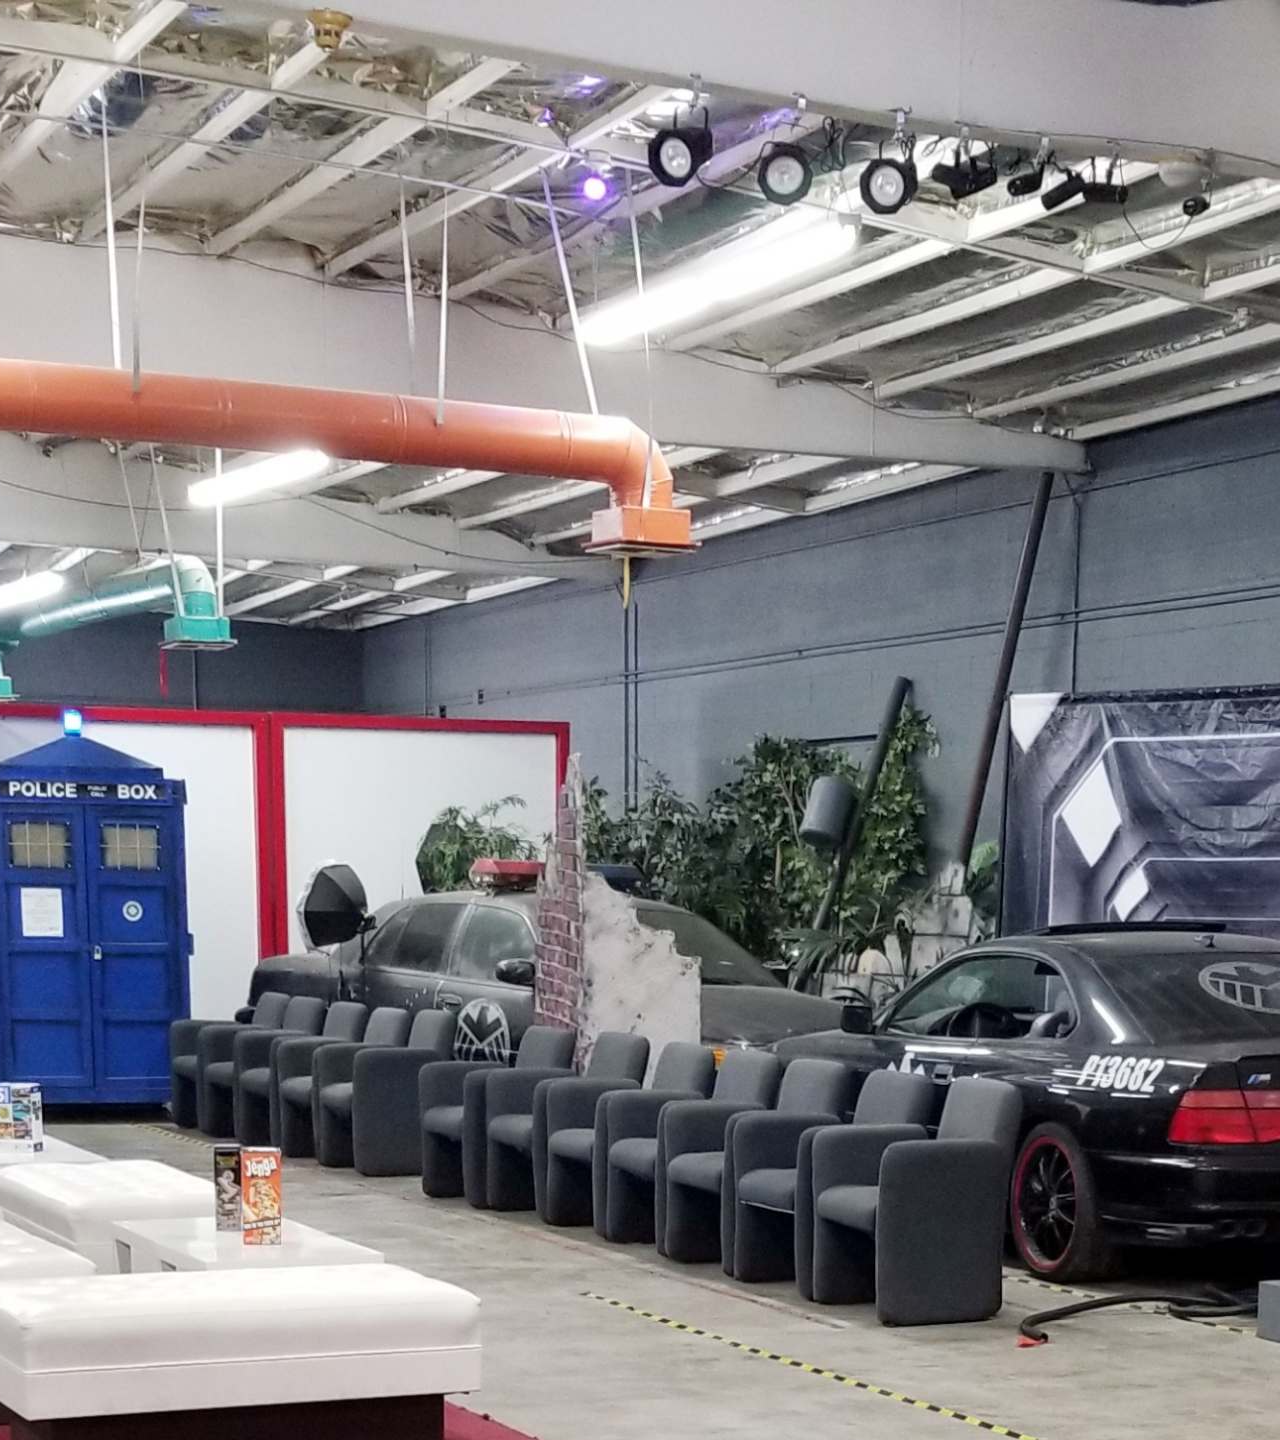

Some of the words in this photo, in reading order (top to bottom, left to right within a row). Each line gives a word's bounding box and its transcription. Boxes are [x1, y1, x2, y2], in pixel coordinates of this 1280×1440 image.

[9, 781, 78, 798] POLICE
[117, 784, 158, 800] BOX
[245, 1157, 277, 1177] Jenga
